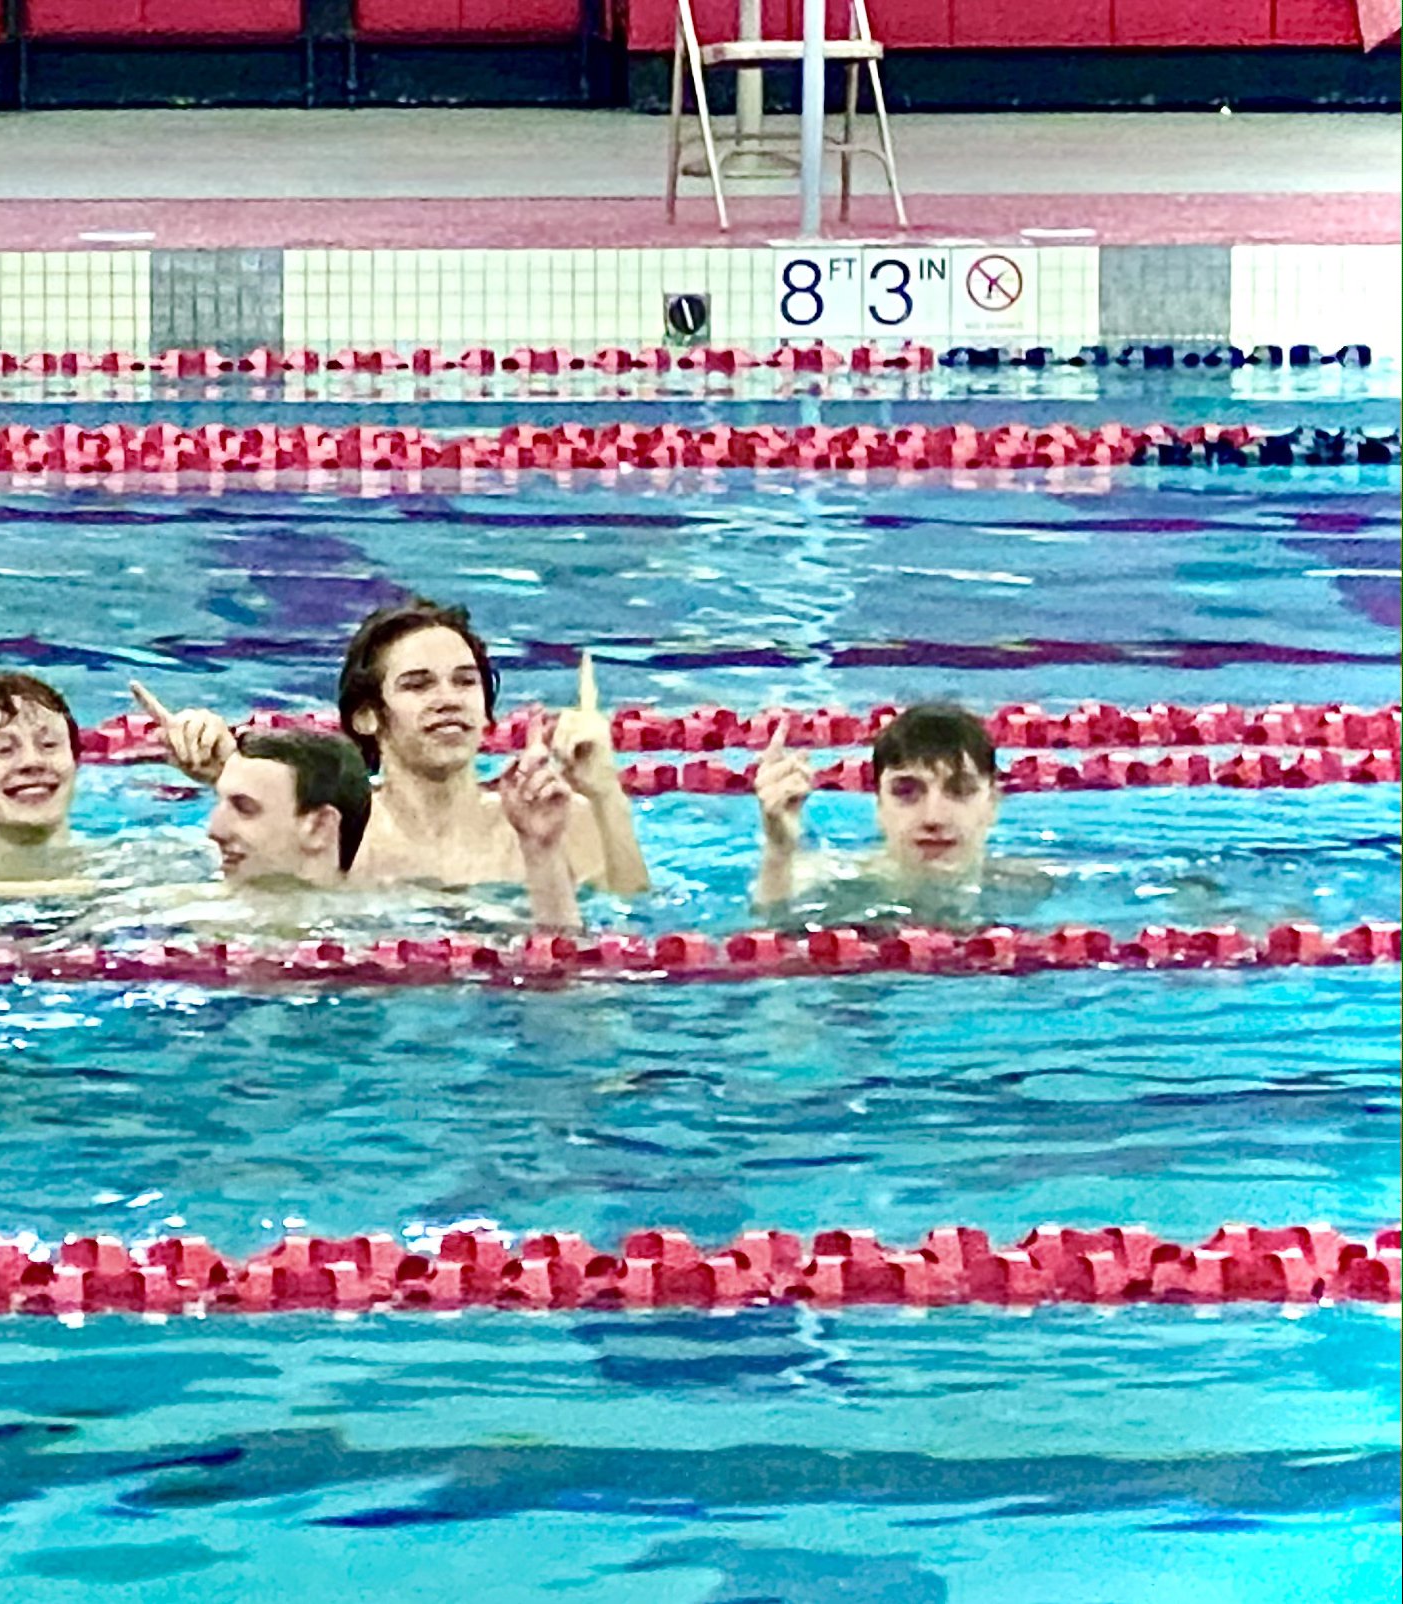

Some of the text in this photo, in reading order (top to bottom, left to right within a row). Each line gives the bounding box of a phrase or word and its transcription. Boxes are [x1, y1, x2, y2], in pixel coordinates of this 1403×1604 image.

[780, 258, 946, 326] 8 FT 3 IN
